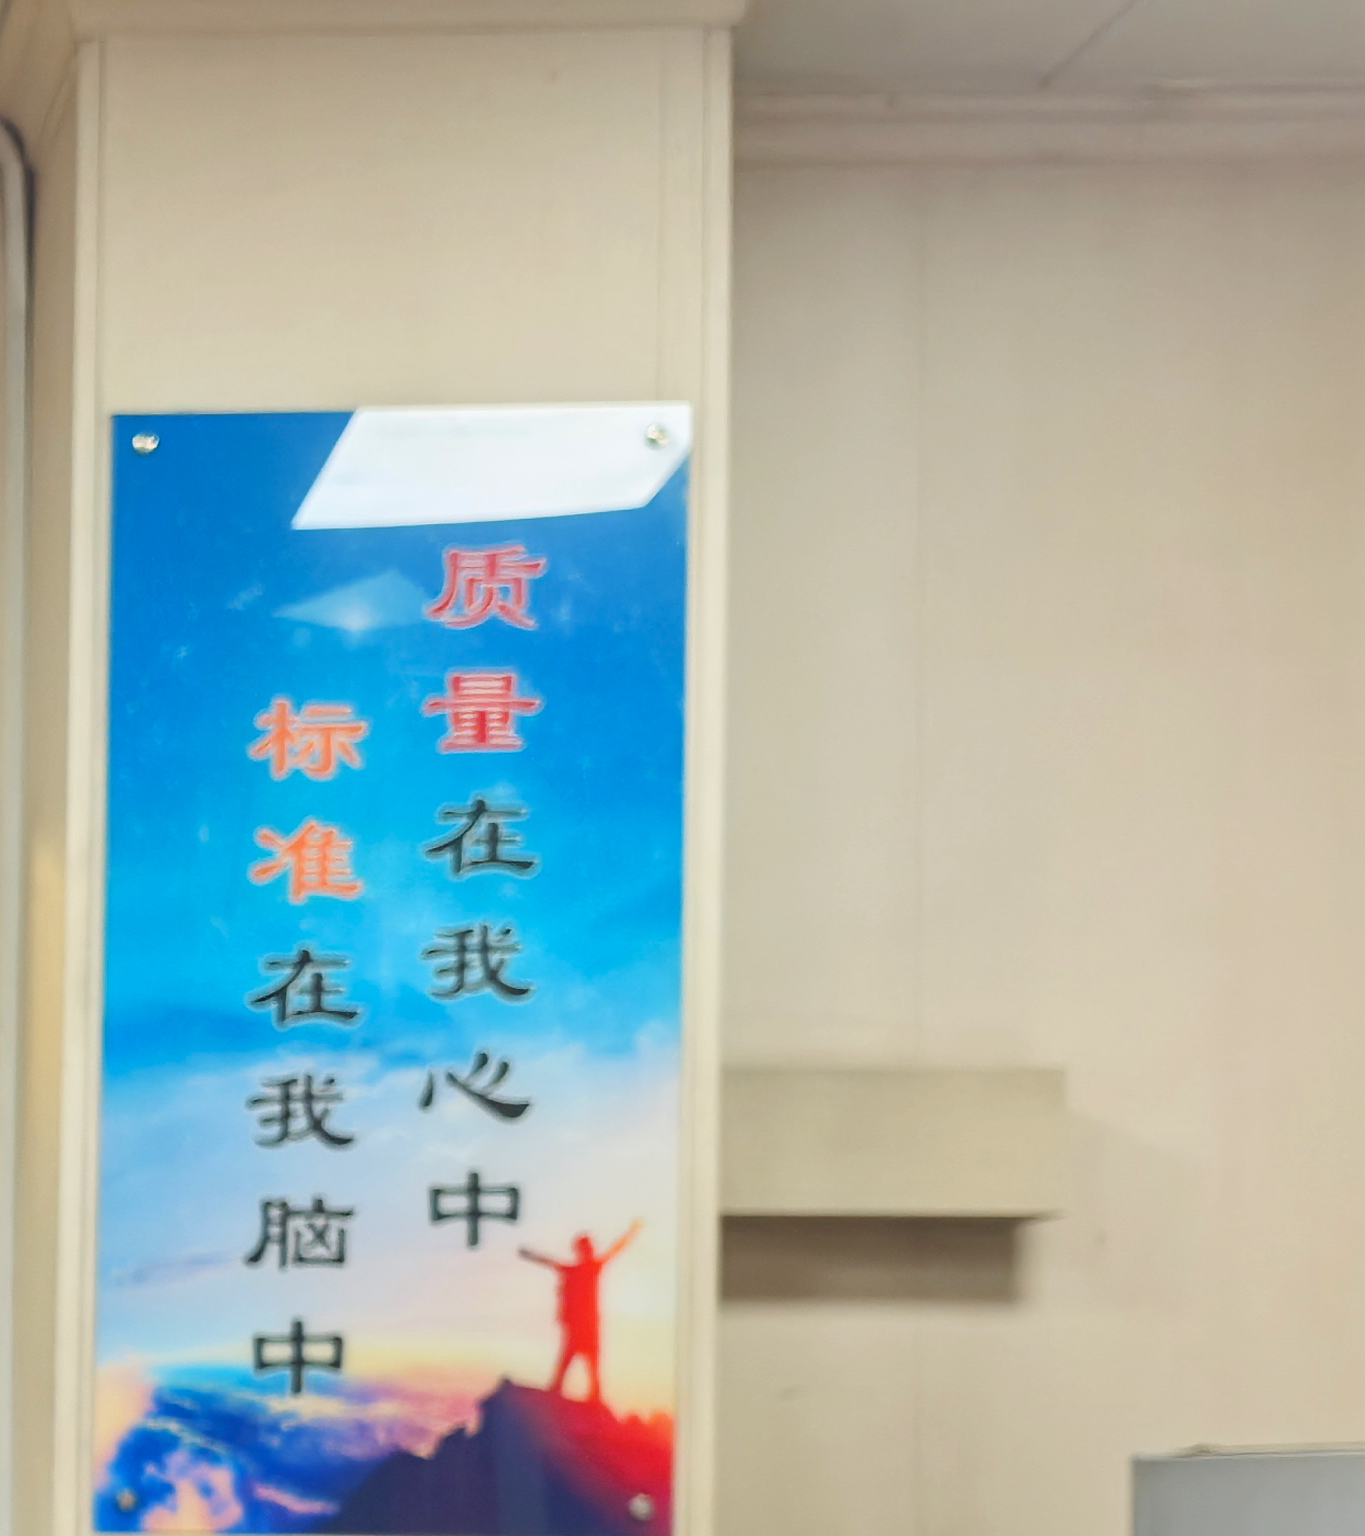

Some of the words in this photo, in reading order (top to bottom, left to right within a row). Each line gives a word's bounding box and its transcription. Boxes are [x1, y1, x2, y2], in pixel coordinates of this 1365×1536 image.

[246, 696, 368, 1396] 标准在我脑中
[421, 544, 545, 1249] 质量在我心中
